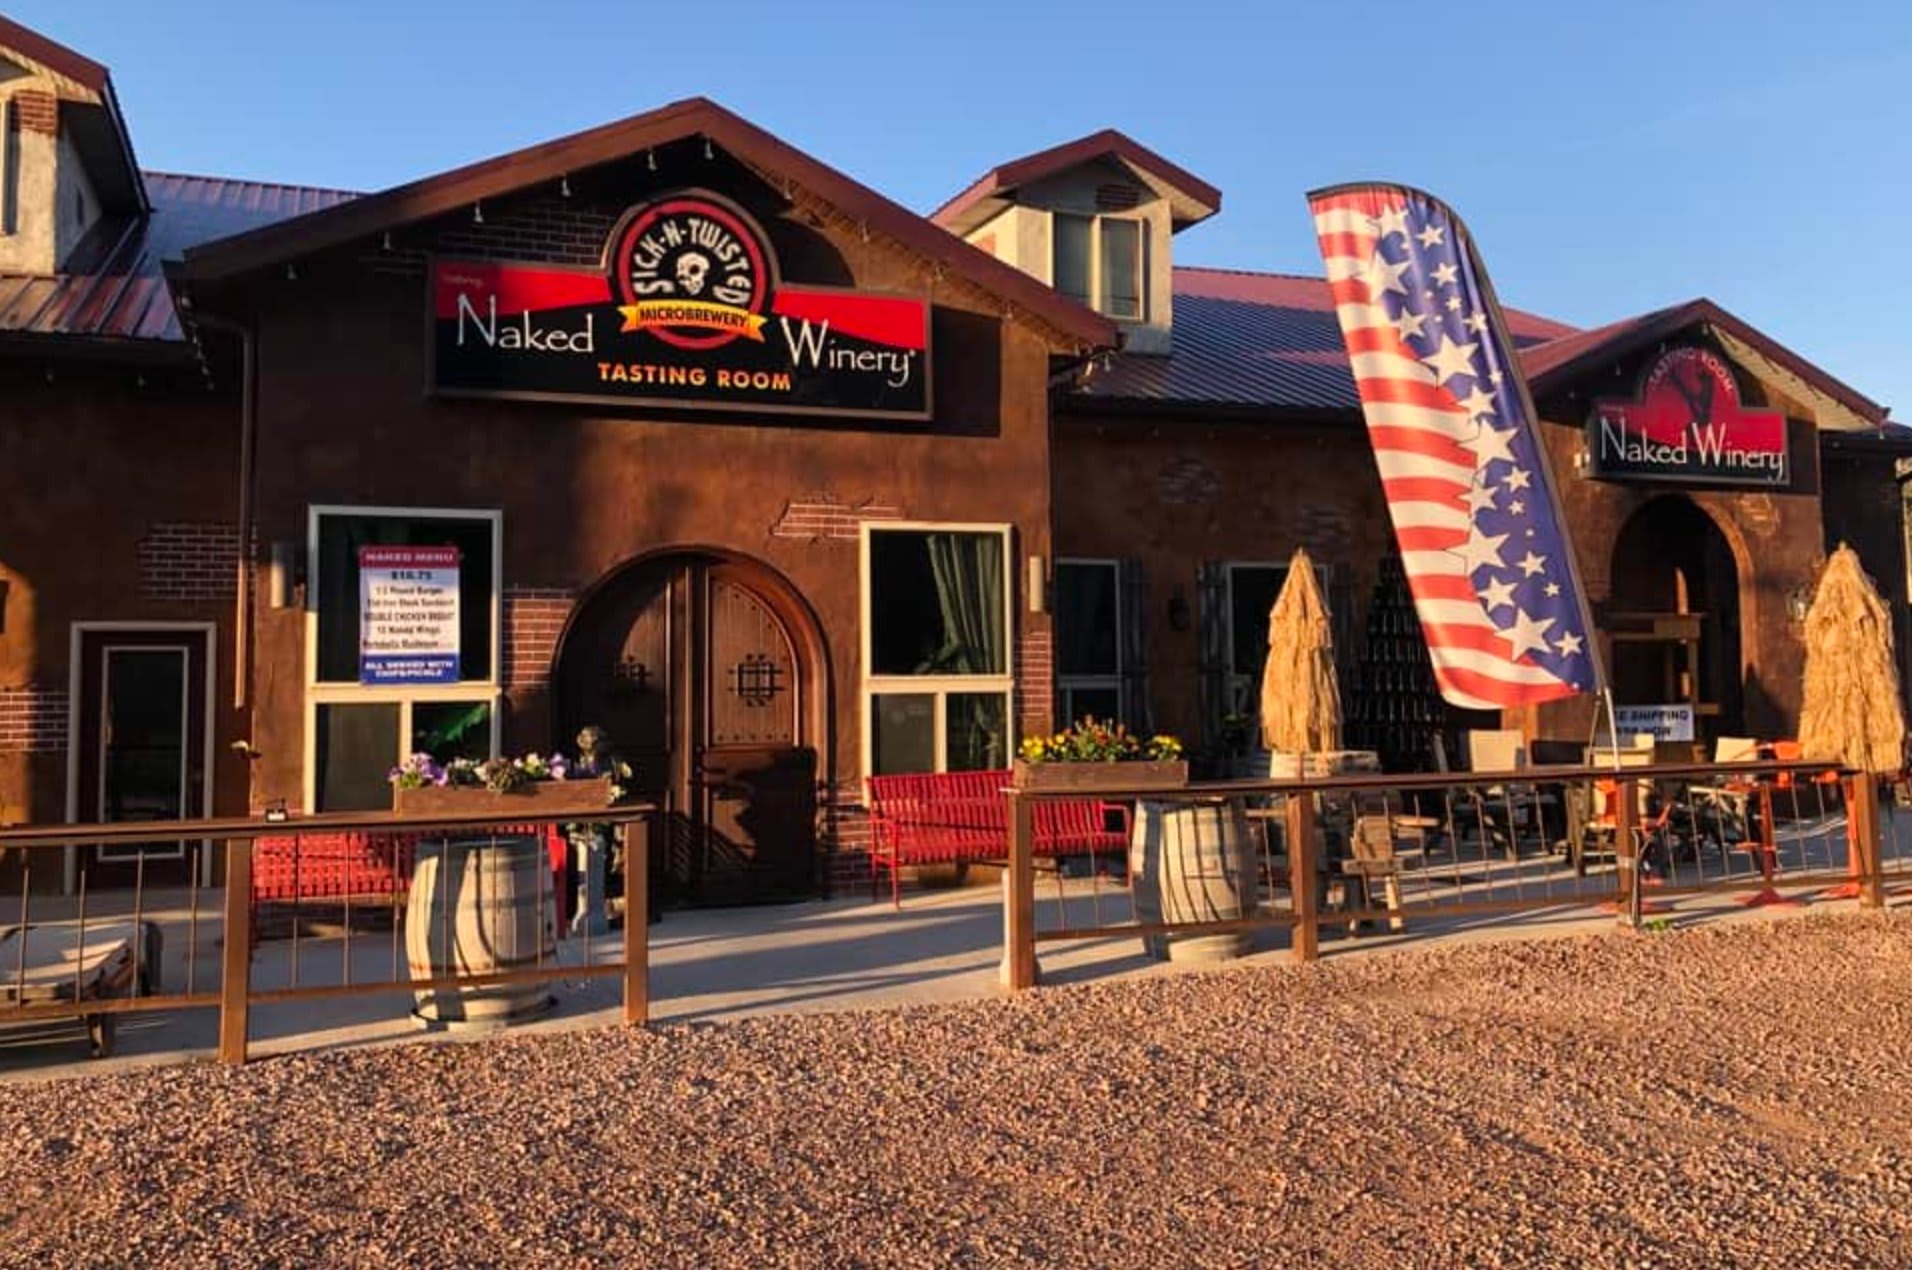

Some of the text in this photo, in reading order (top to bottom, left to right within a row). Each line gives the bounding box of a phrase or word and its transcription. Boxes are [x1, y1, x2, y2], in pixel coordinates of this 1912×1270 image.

[639, 307, 748, 328] MICROBREWERY
[456, 292, 913, 387] Naked Winery
[598, 361, 791, 391] TASTING ROOM
[1701, 351, 1735, 393] ROOM
[1600, 415, 1786, 484] Naked Winery
[365, 552, 453, 562] NAKED MENU
[1631, 709, 1689, 721] SHIPPING
